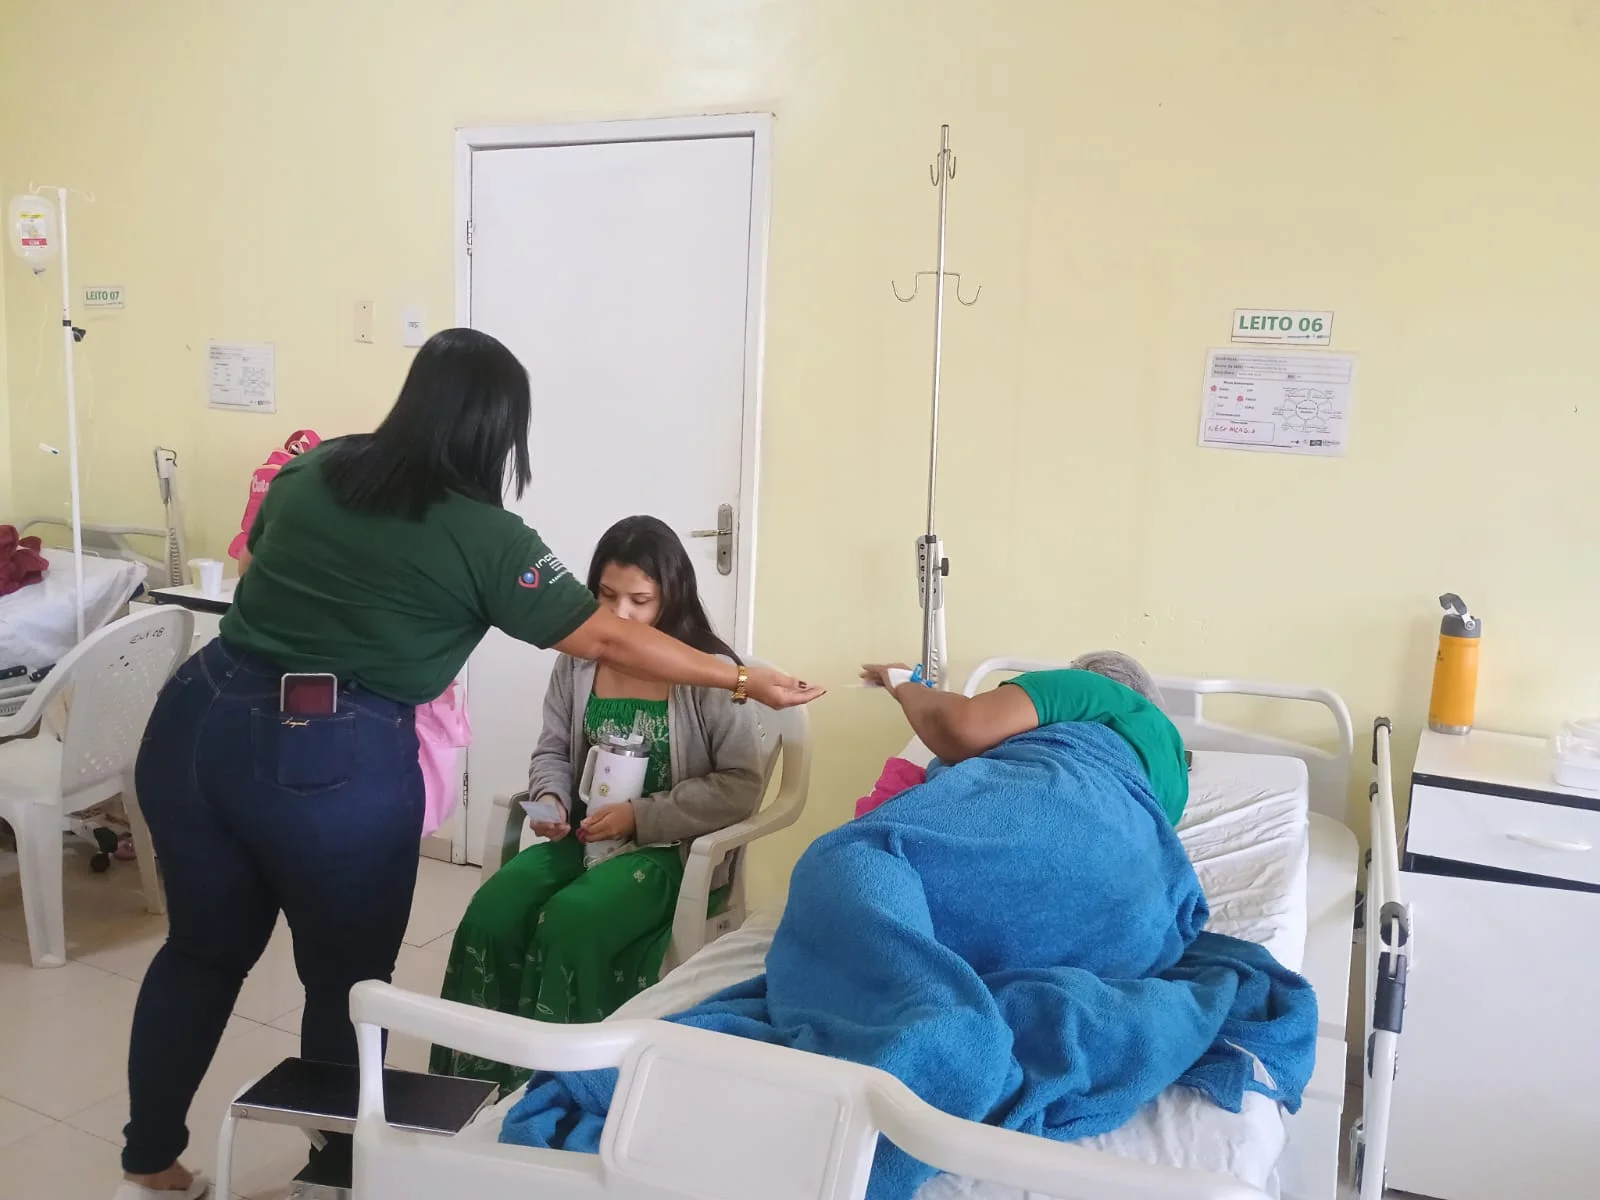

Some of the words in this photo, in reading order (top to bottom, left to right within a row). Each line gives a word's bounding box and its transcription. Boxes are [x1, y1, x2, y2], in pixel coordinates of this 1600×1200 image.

[86, 291, 108, 301] LEITO
[109, 291, 120, 301] 07
[1239, 315, 1293, 331] LEITO
[1298, 317, 1323, 332] 06
